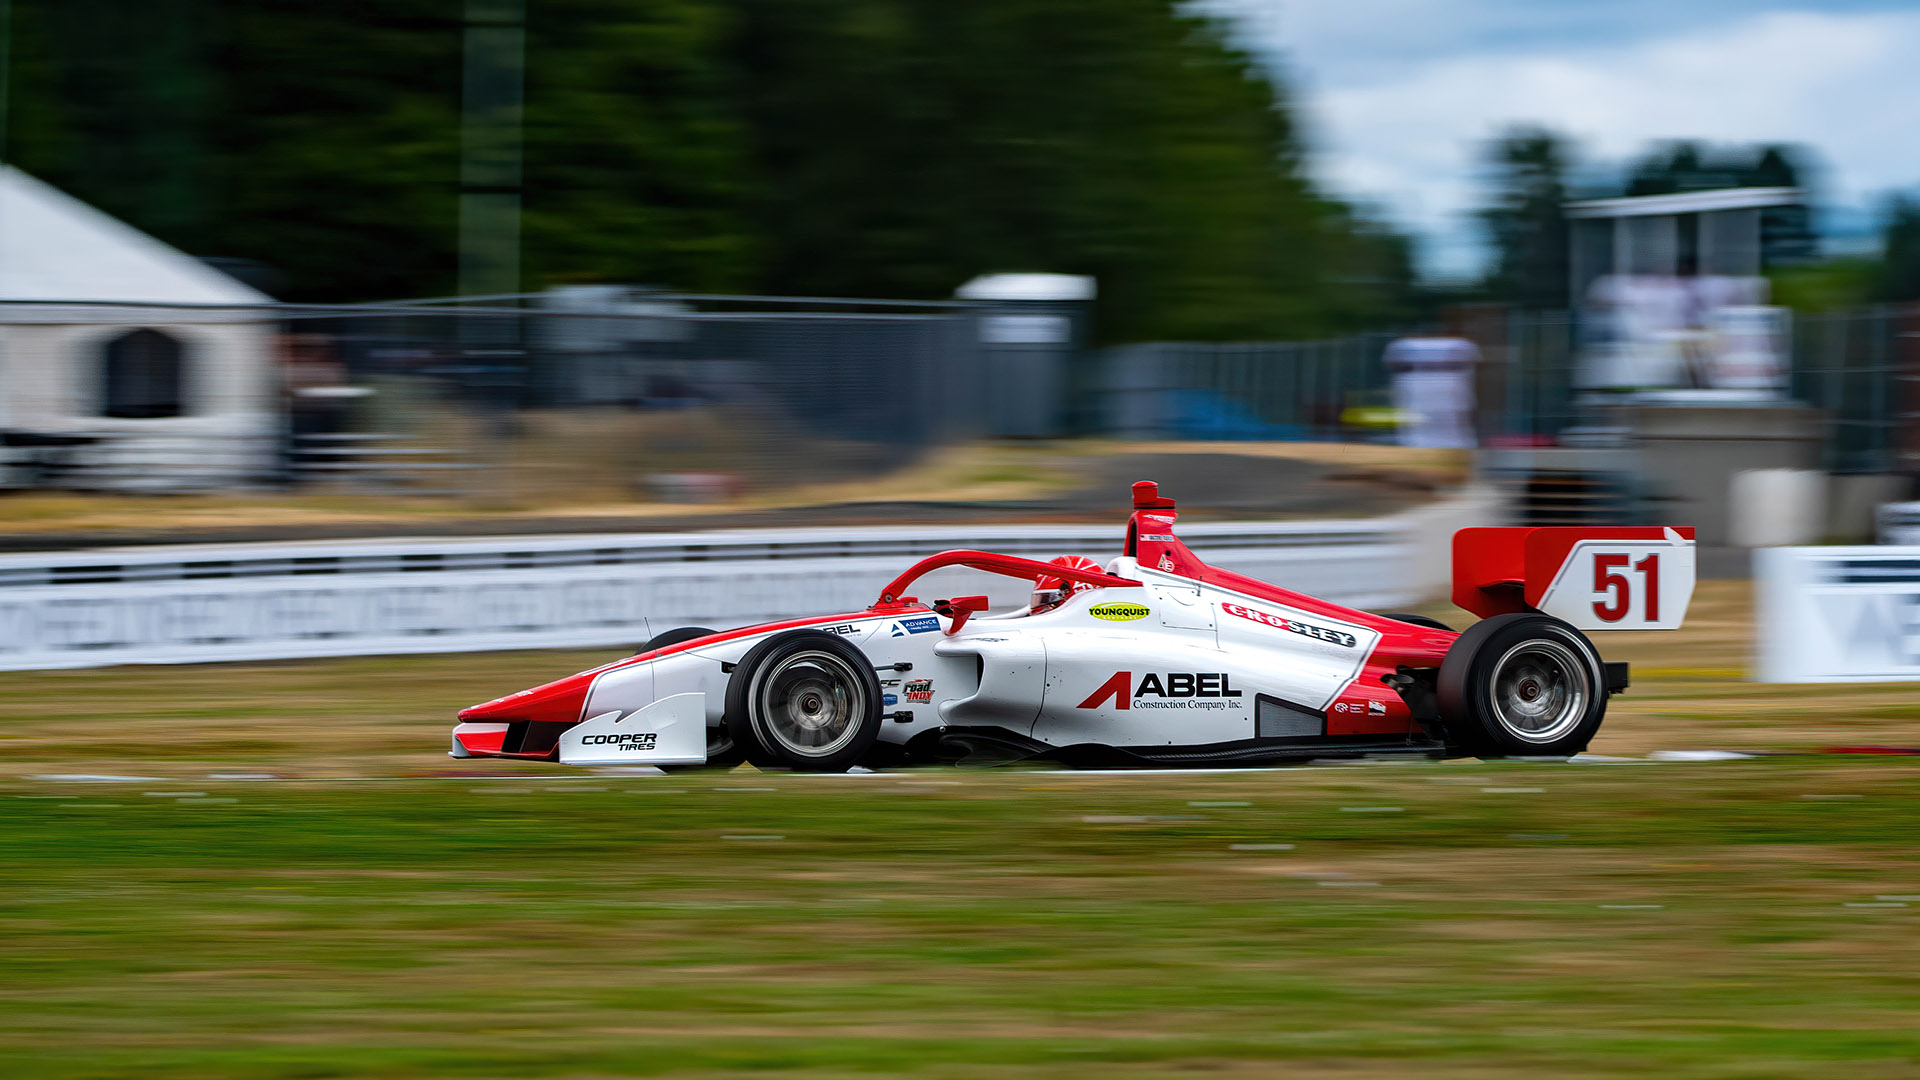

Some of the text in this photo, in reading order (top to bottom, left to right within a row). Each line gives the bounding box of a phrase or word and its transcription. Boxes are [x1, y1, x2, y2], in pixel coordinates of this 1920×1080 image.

[1592, 553, 1660, 623] 51
[1089, 608, 1150, 616] YOUNGQUIST
[905, 619, 937, 627] ADVANCE
[1227, 604, 1354, 647] CROSLEY
[823, 624, 861, 635] BEL
[1134, 673, 1242, 697] ABEL
[907, 691, 931, 701] INDY
[1133, 700, 1243, 711] Construction Company Inc.
[581, 733, 657, 745] COOPER
[618, 743, 656, 751] TIRES
